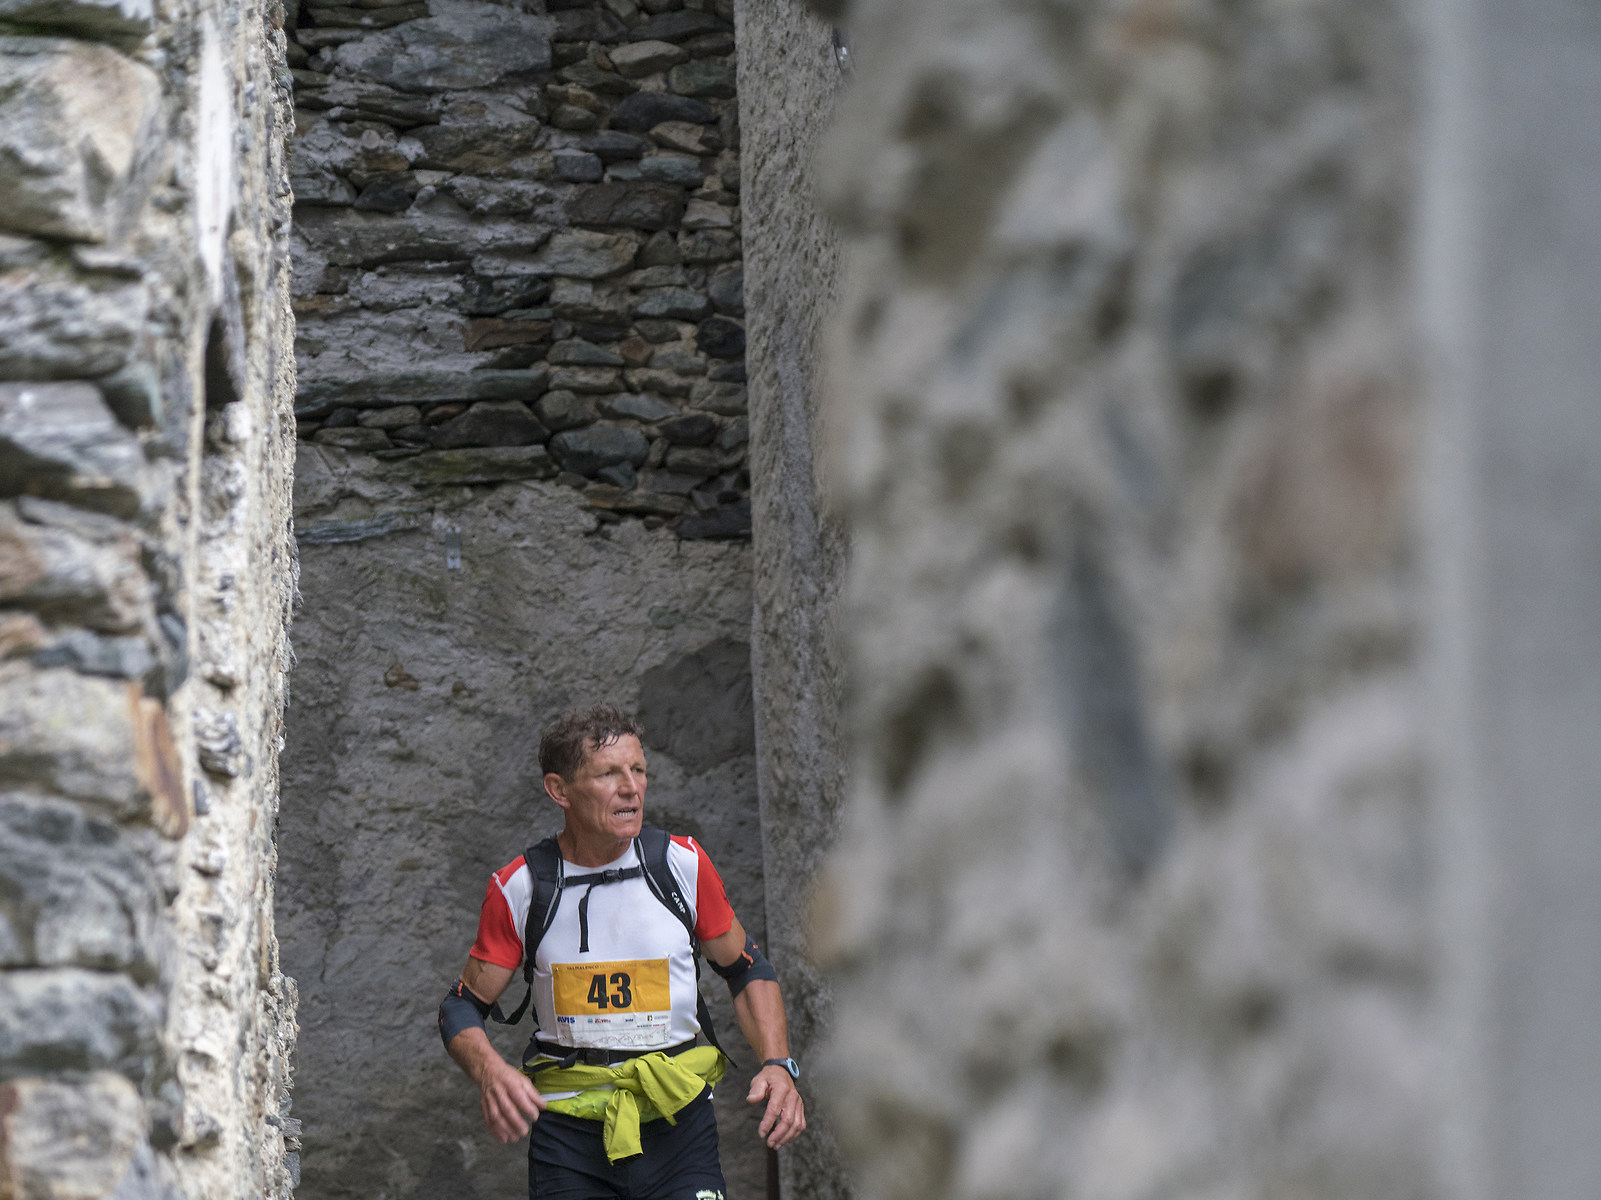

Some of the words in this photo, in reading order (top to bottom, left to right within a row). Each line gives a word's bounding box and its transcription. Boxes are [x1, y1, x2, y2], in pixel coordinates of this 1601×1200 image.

[671, 891, 686, 914] CAMP
[587, 972, 632, 1009] 43
[557, 1016, 576, 1024] AVIS
